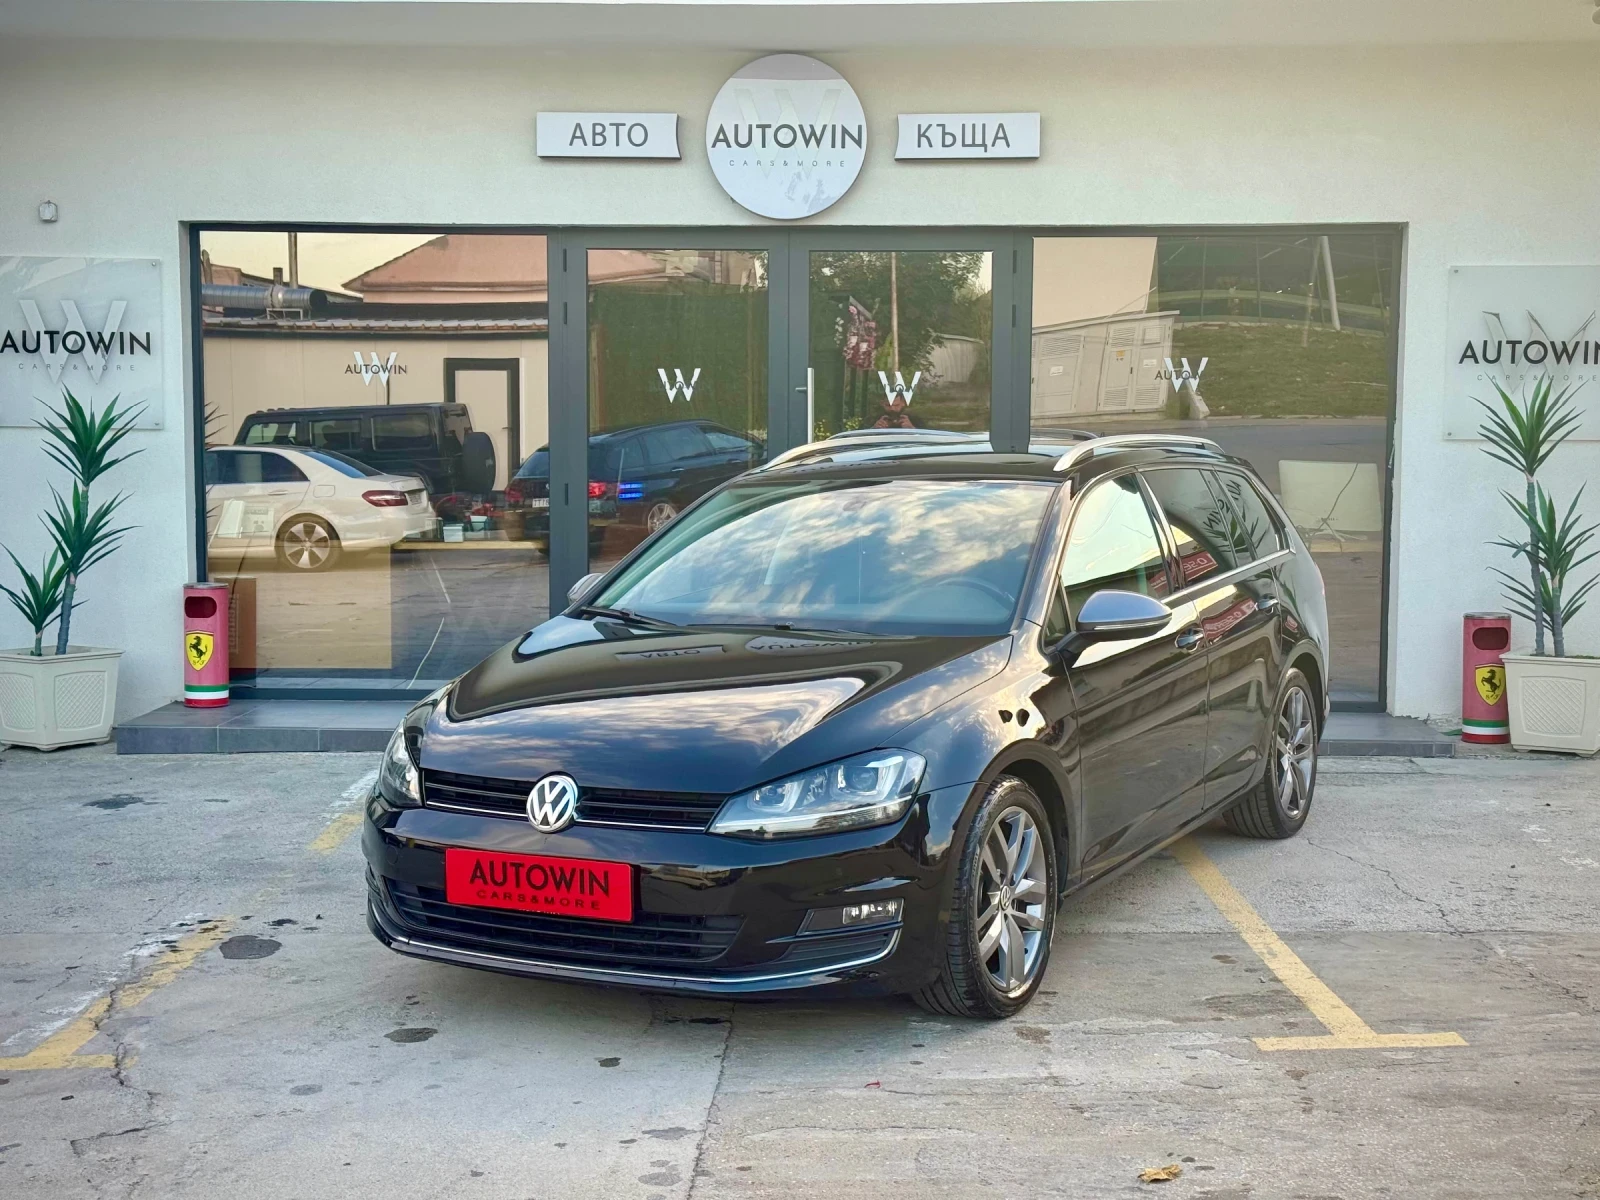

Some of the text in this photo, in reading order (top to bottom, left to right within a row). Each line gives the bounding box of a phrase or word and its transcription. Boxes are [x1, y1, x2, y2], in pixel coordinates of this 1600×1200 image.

[568, 122, 649, 147] АВТО
[711, 123, 863, 149] AUTOWIN
[917, 122, 1011, 153] КЪЩА
[728, 159, 845, 167] CARS&MORE
[0, 329, 151, 355] AUTOWIN
[18, 362, 136, 372] CARS&MORE
[344, 363, 407, 375] AUTOWIN
[657, 368, 702, 404] W
[877, 370, 922, 407] W
[469, 858, 609, 898] AUTOWIN
[476, 889, 600, 910] CARS&MORE
